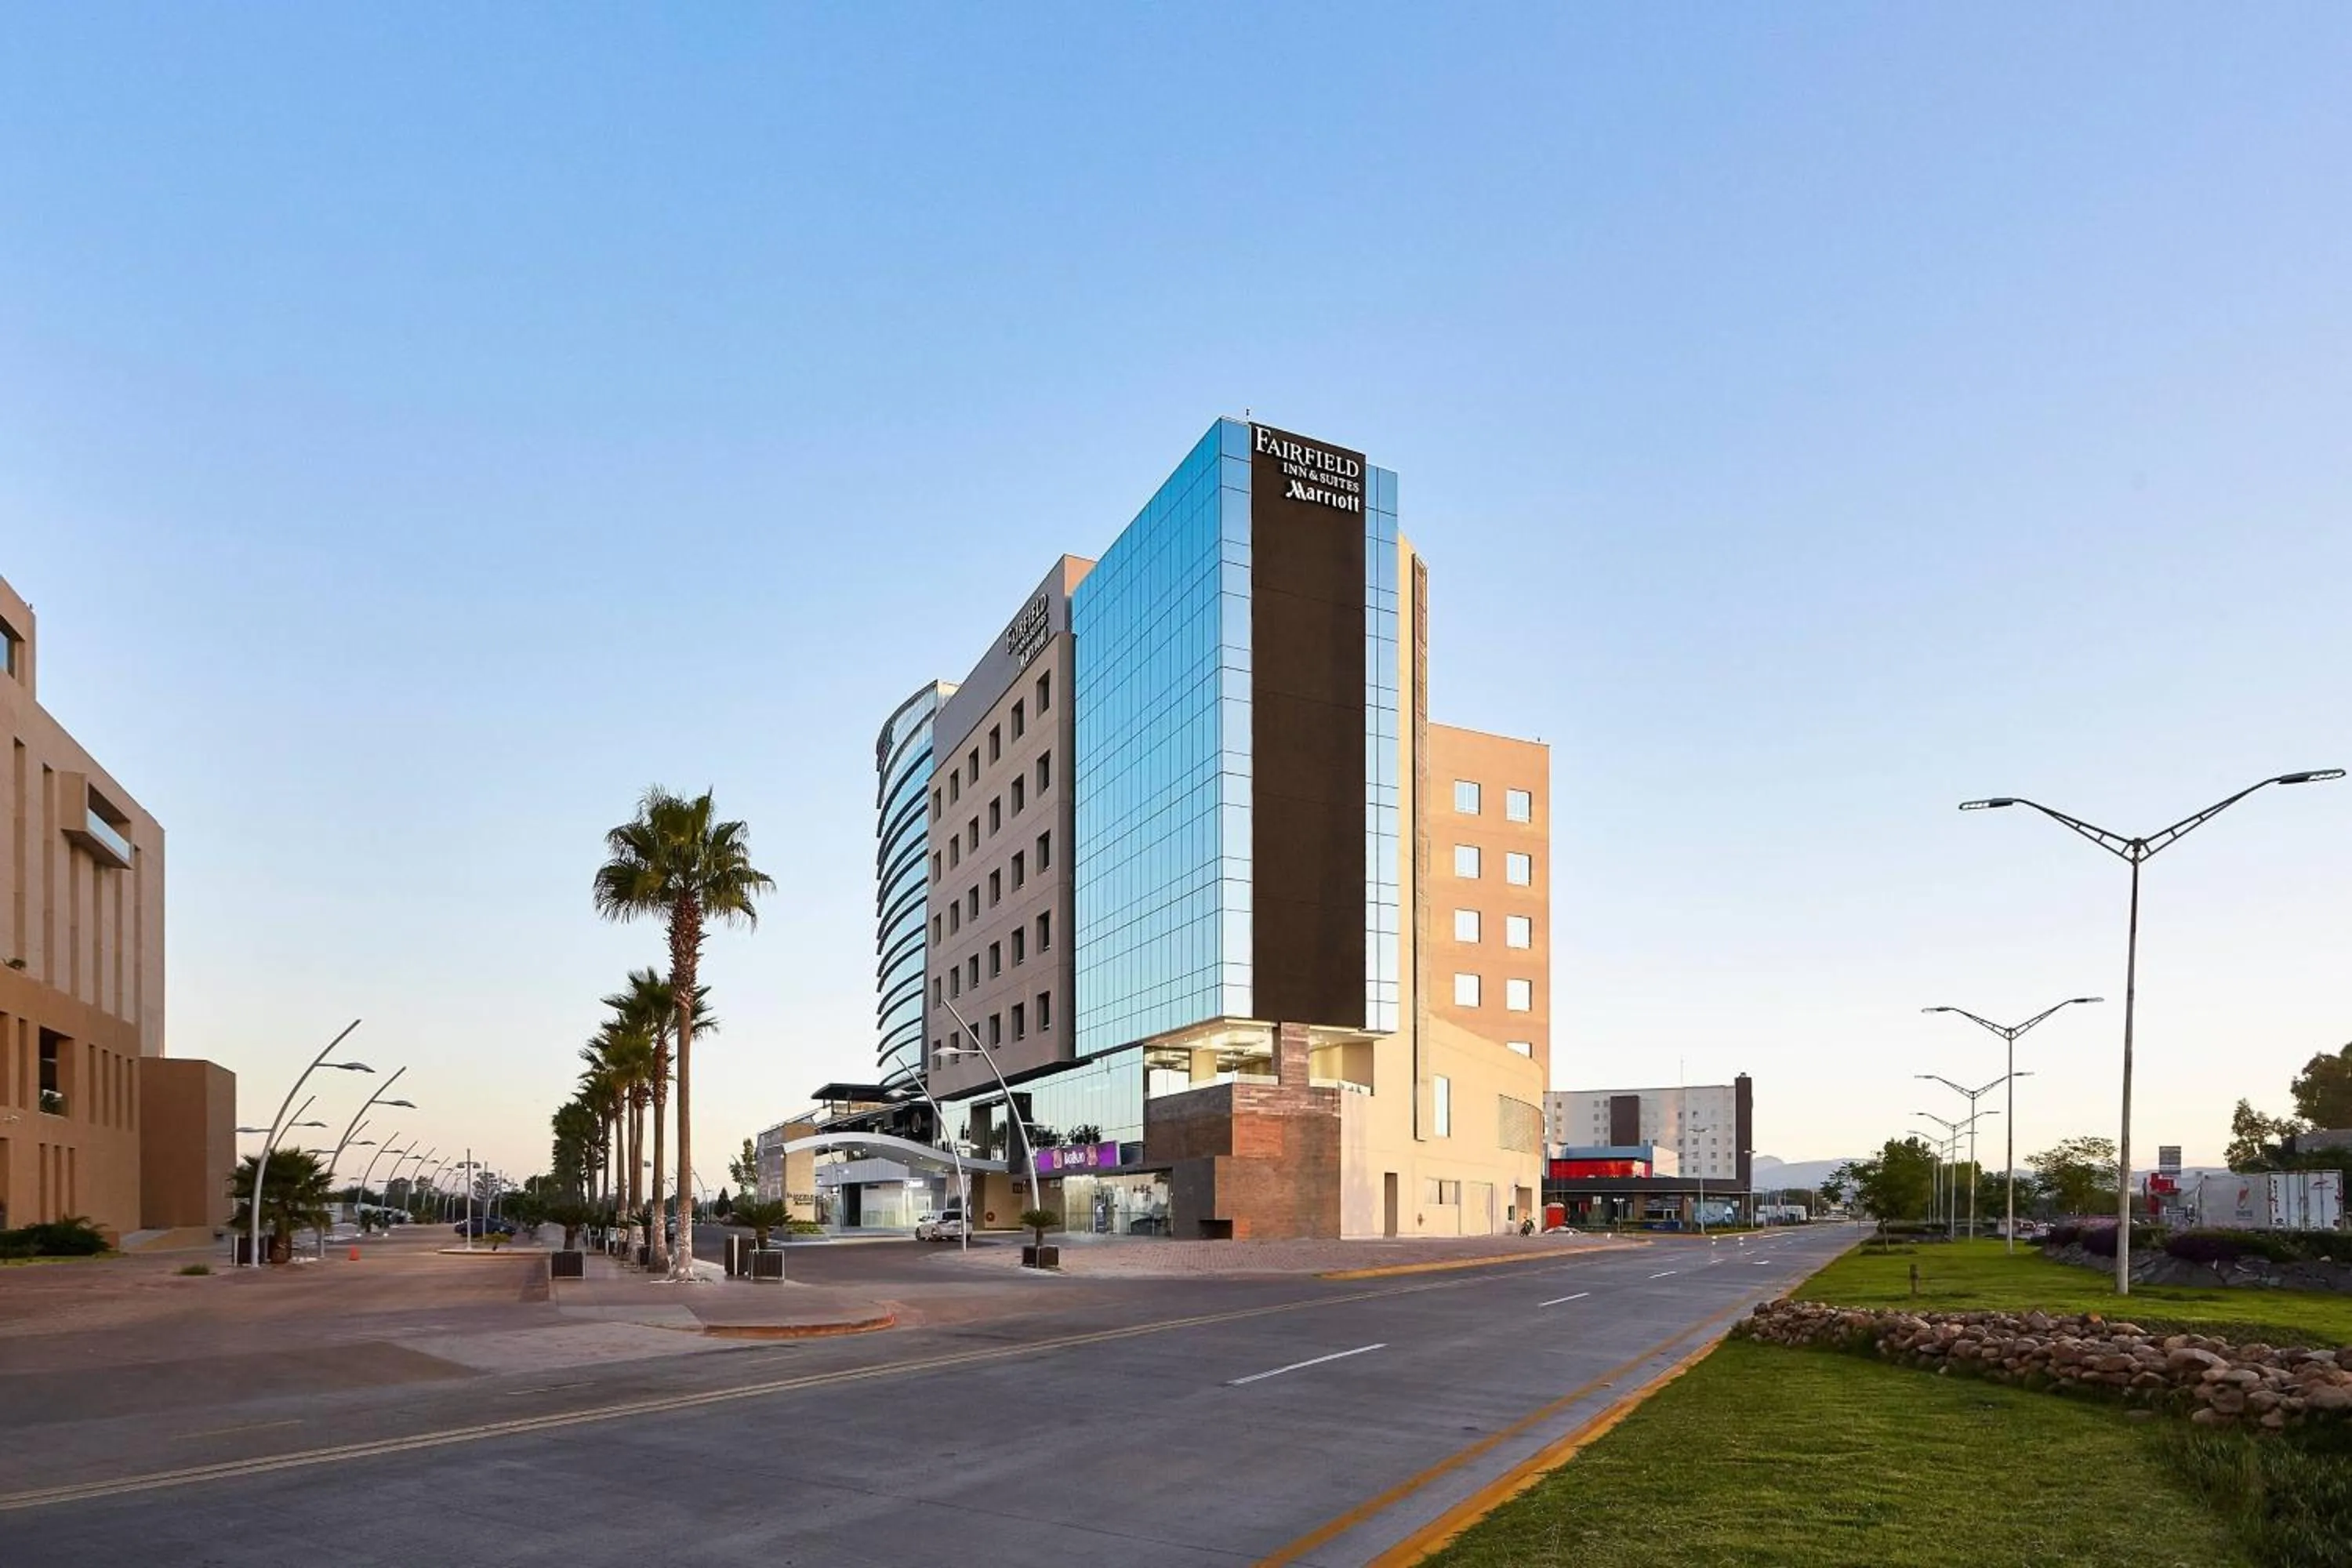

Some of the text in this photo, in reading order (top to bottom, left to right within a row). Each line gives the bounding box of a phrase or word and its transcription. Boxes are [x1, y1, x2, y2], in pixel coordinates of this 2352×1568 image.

[1255, 426, 1359, 477] FAIRFIELD
[1283, 462, 1308, 479] INN
[1320, 473, 1359, 493] SUITES
[1286, 479, 1359, 513] Marriott
